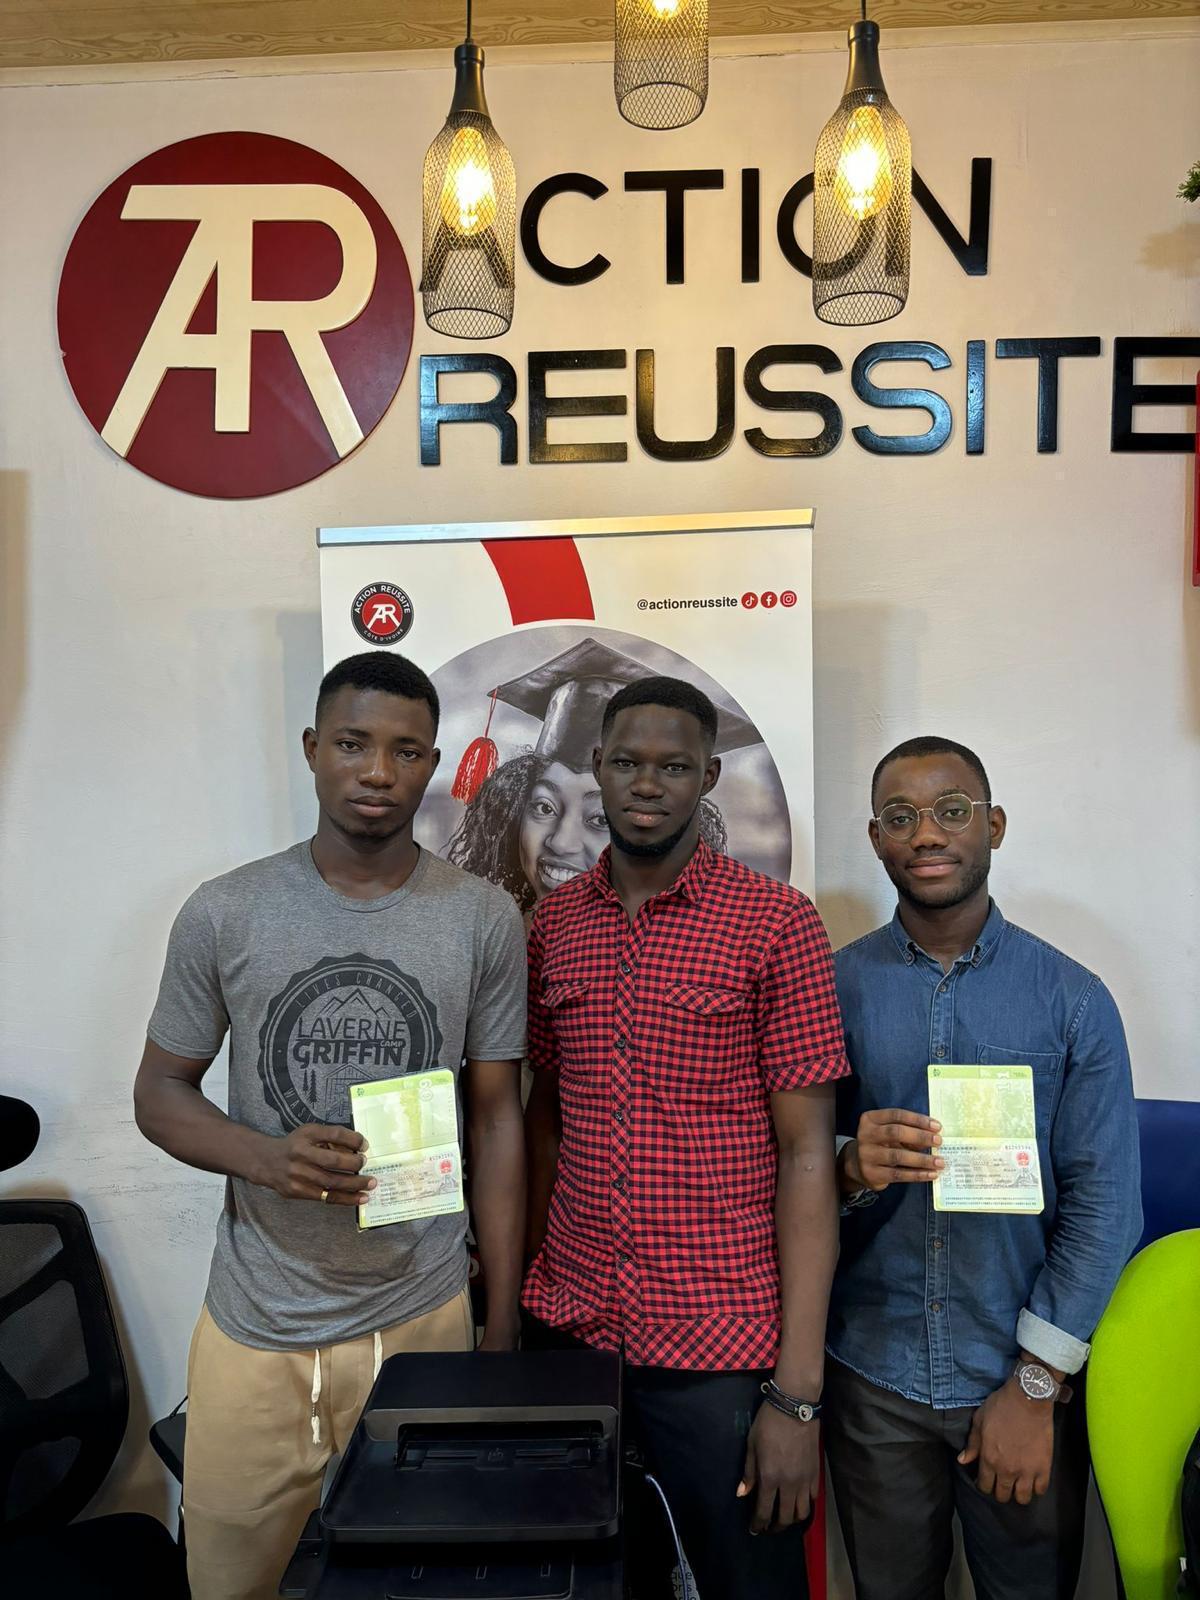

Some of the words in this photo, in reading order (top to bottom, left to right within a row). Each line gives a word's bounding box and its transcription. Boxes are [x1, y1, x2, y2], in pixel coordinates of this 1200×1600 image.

[419, 157, 992, 292] ACTION
[419, 336, 1200, 467] REUSSITE
[354, 586, 377, 614] ACTION
[380, 585, 411, 614] REUSSITE
[637, 596, 738, 610] @actionreussite
[296, 974, 341, 1008] LIVES
[356, 972, 418, 1019] CHANGED
[297, 1016, 407, 1040] LAVERNE
[379, 1039, 404, 1048] CAMP
